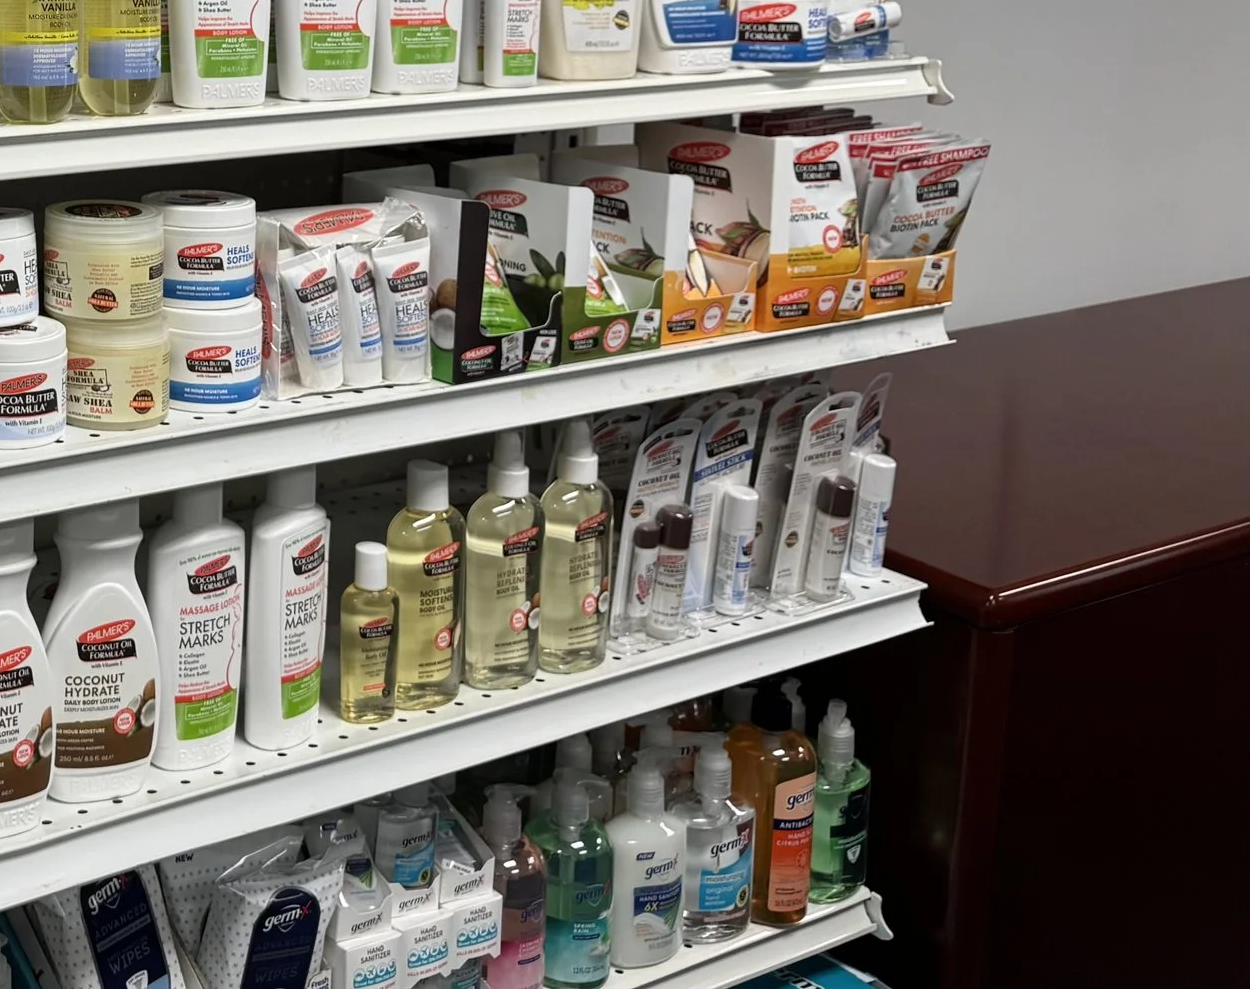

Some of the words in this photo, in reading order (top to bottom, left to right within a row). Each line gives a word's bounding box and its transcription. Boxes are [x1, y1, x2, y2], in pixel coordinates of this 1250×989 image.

[41, 3, 76, 11] VANILLA
[920, 154, 939, 166] FREE
[940, 148, 988, 161] SHAMPOO
[890, 220, 918, 232] BIOTIN
[920, 218, 938, 228] PACK
[227, 245, 250, 255] HEALS
[396, 300, 427, 317] HEALS
[236, 346, 257, 358] HEALS
[0, 375, 42, 392] PALMER'S
[26, 391, 54, 402] BUTTER
[84, 397, 112, 407] SHEA
[1, 403, 45, 413] FORMULA
[180, 613, 231, 635] STRETCH
[179, 630, 224, 649] MARKS
[65, 673, 125, 686] COCONUT
[65, 685, 120, 698] HYDRATE
[470, 906, 486, 915] HAND
[464, 912, 492, 924] SANITIZER
[367, 945, 384, 955] HAND
[361, 950, 390, 964] SANITIZER
